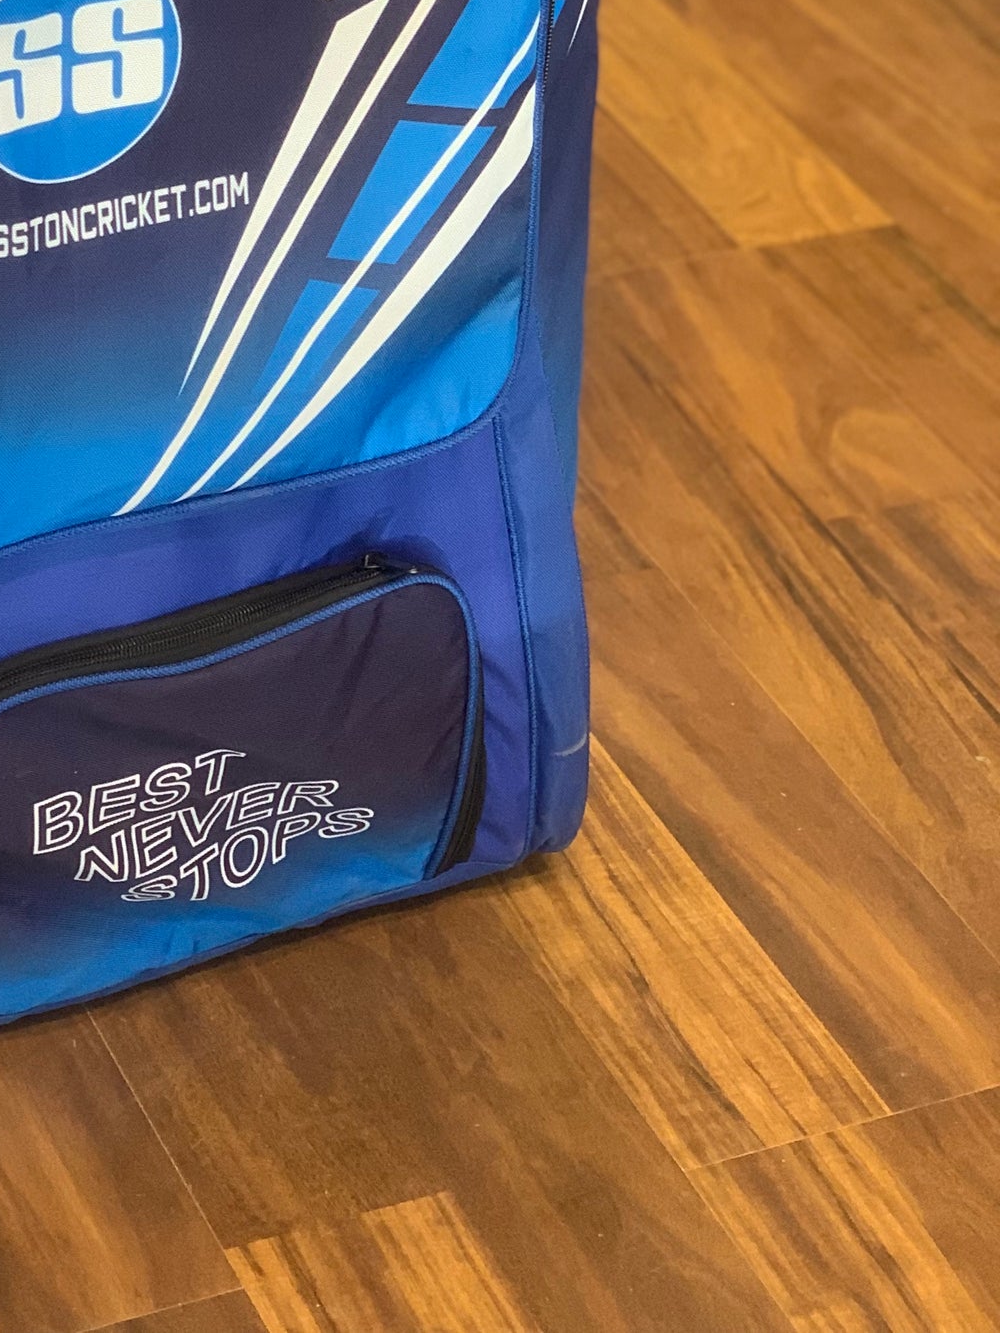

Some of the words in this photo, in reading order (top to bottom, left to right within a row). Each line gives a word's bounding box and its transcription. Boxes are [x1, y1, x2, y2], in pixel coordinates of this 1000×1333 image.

[33, 749, 247, 855] BEST
[74, 780, 340, 883] NEVER
[121, 808, 375, 902] STOPS
